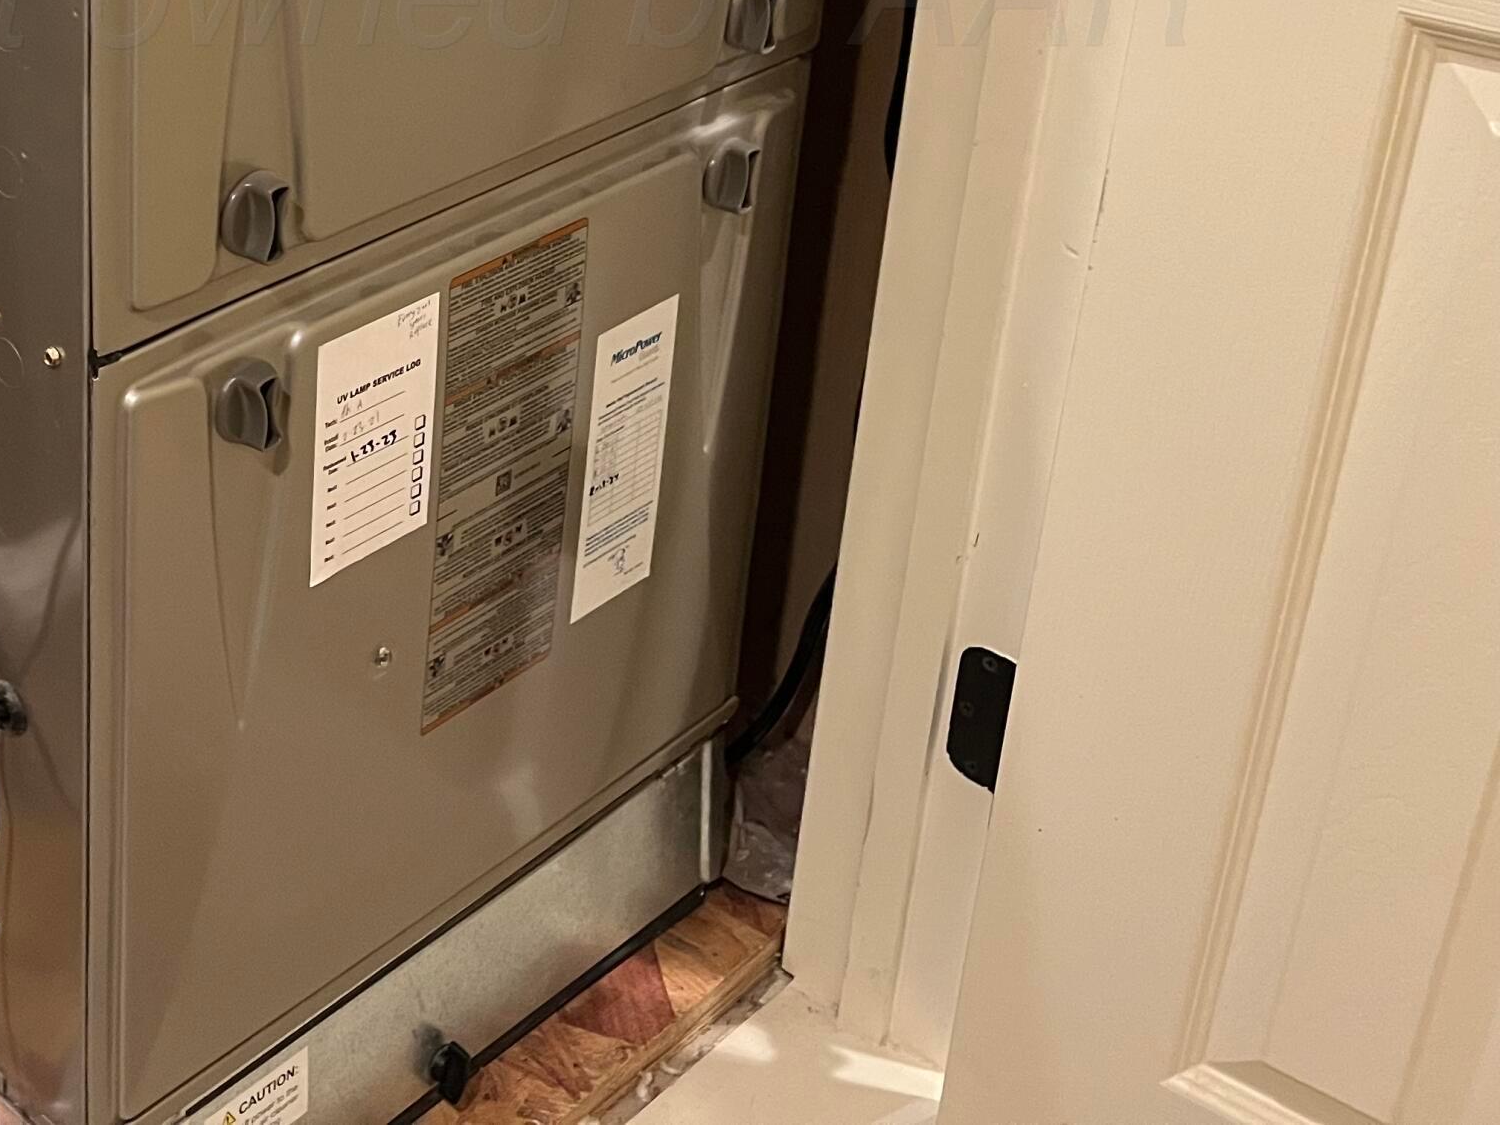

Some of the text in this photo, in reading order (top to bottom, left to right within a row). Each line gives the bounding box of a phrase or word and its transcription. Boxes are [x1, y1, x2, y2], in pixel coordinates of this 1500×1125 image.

[610, 331, 663, 367] MicroPower
[336, 359, 421, 405] UV LAMP SERVICE LOG
